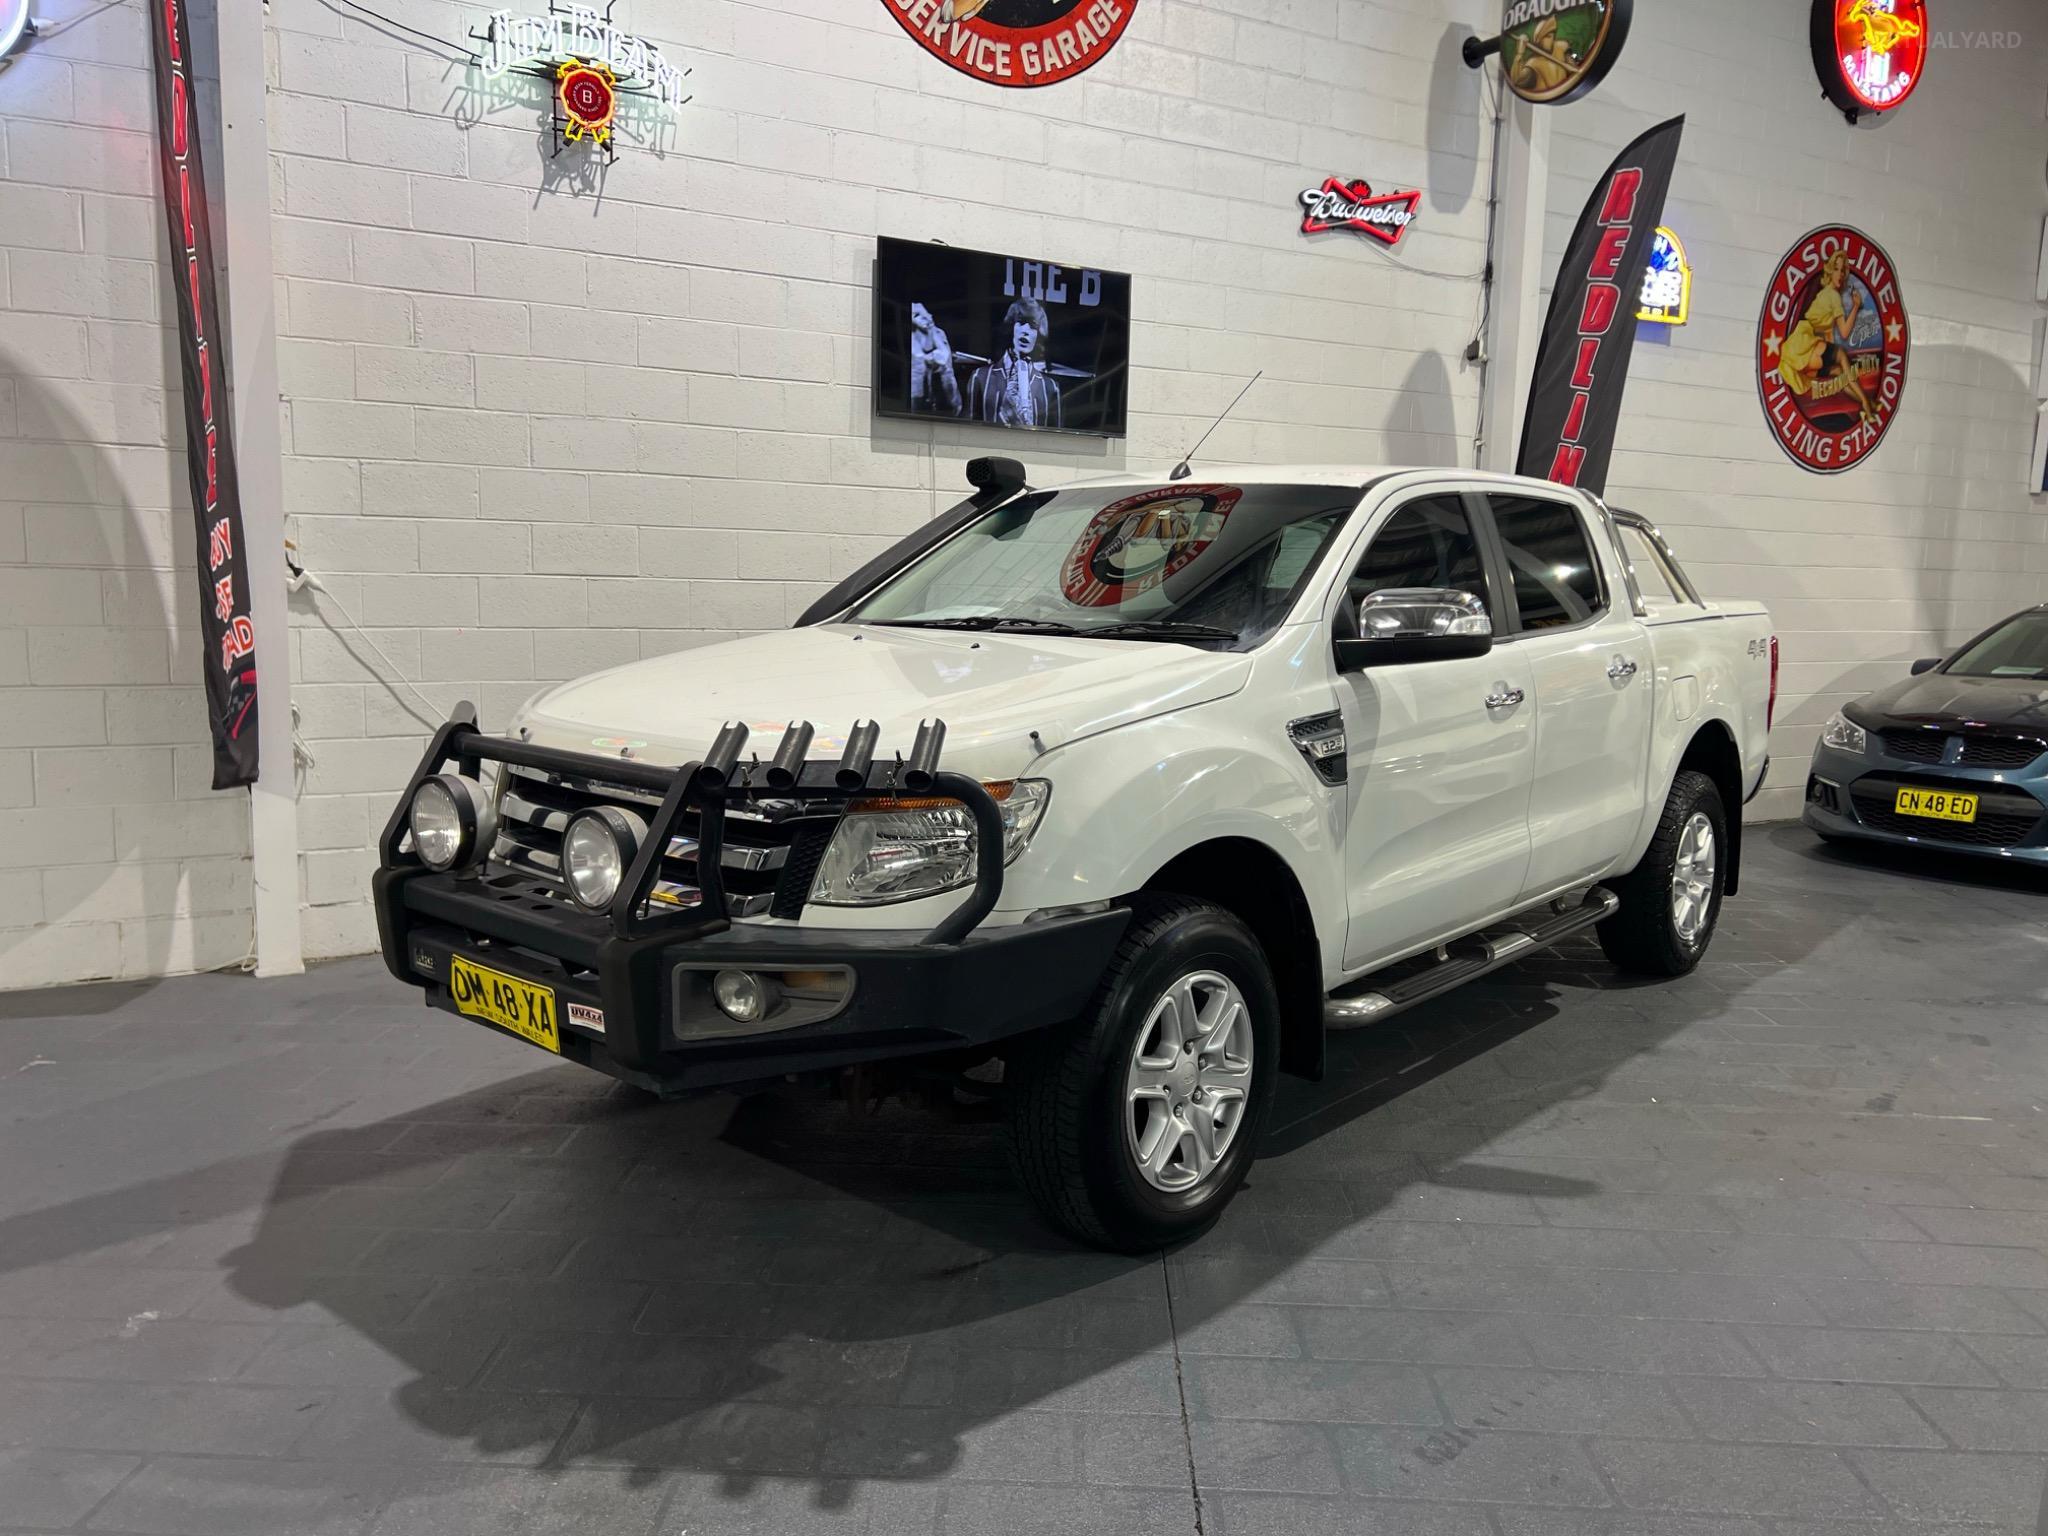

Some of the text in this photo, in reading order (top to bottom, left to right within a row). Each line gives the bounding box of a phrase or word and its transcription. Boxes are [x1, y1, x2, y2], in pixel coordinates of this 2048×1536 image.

[1021, 0, 1122, 77] GARAGE
[1503, 0, 1599, 31] DRAUG
[482, 2, 687, 114] JIM BEAM
[1303, 188, 1413, 226] Budweiser
[1770, 235, 1896, 322] GASOLINE
[1765, 353, 1902, 462] FILLING STATION
[1899, 792, 1973, 816] CN 48 ED
[454, 966, 554, 1036] DM 48 XA
